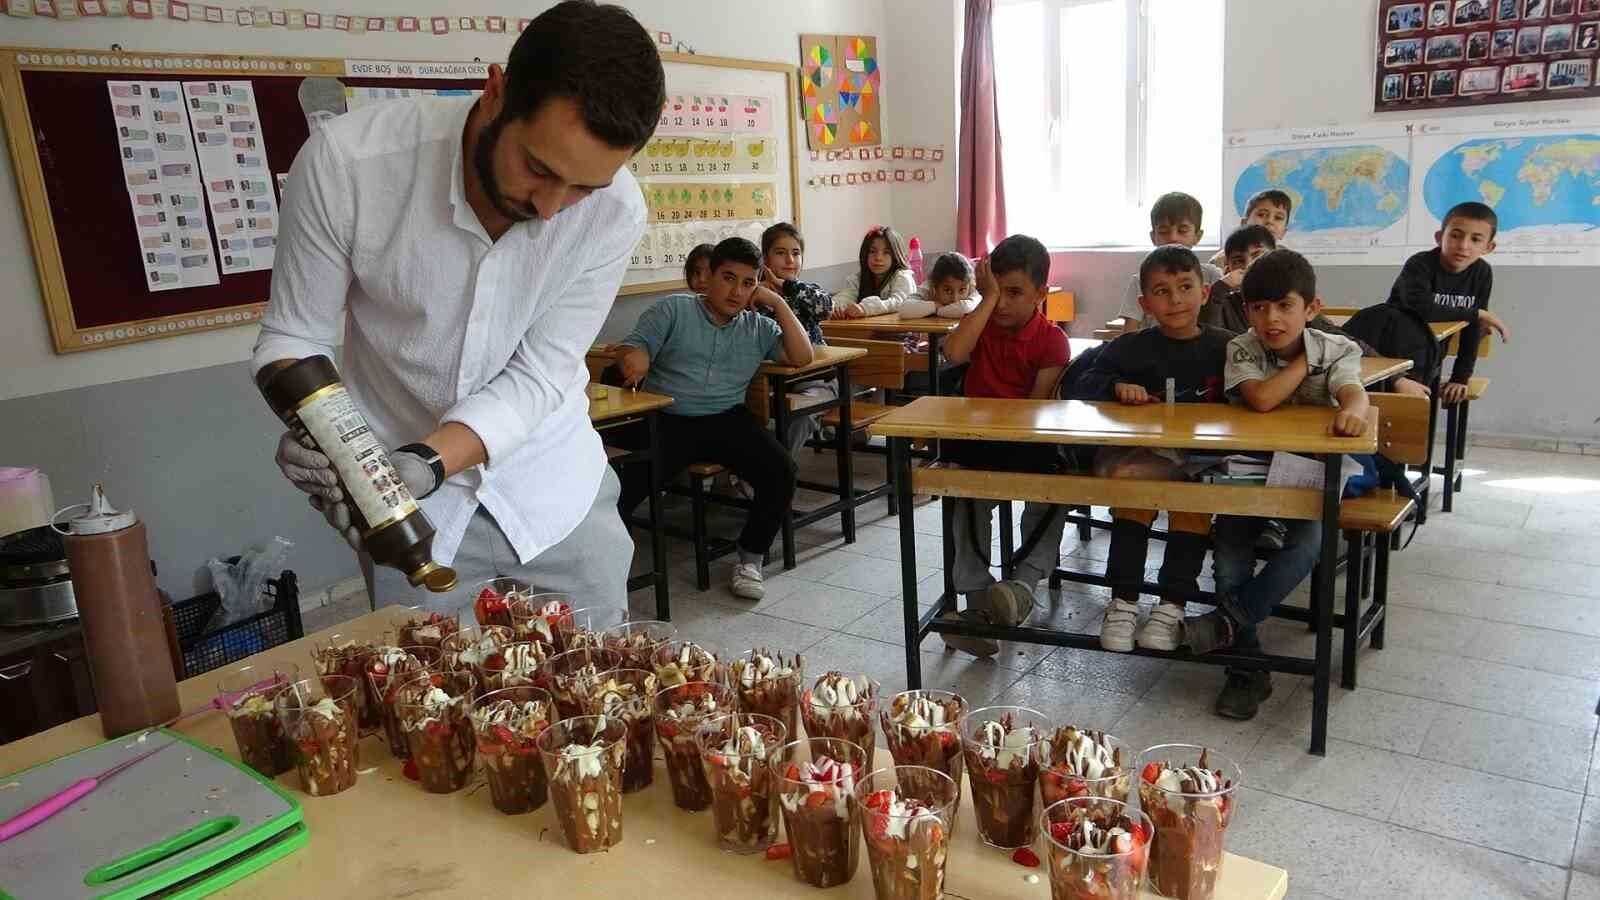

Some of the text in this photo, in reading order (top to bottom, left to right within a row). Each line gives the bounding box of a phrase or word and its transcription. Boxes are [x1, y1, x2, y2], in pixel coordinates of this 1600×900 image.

[352, 64, 373, 73] EVDE
[375, 64, 391, 75] BOŞ
[660, 117, 668, 126] 10
[674, 117, 682, 126] 12
[692, 117, 700, 126] 14
[706, 118, 714, 126] 16
[720, 118, 728, 127] 18
[632, 163, 638, 172] 9
[650, 163, 660, 172] 12
[664, 163, 672, 172] 15
[679, 163, 688, 172] 18
[696, 162, 704, 172] 21
[709, 162, 717, 172] 24
[722, 162, 730, 172] 27
[657, 212, 665, 220] 16
[672, 211, 680, 219] 20
[684, 210, 692, 218] 24
[699, 210, 708, 218] 28
[713, 210, 721, 218] 32
[728, 209, 734, 217] 36
[631, 254, 686, 265] 10 15 20 25
